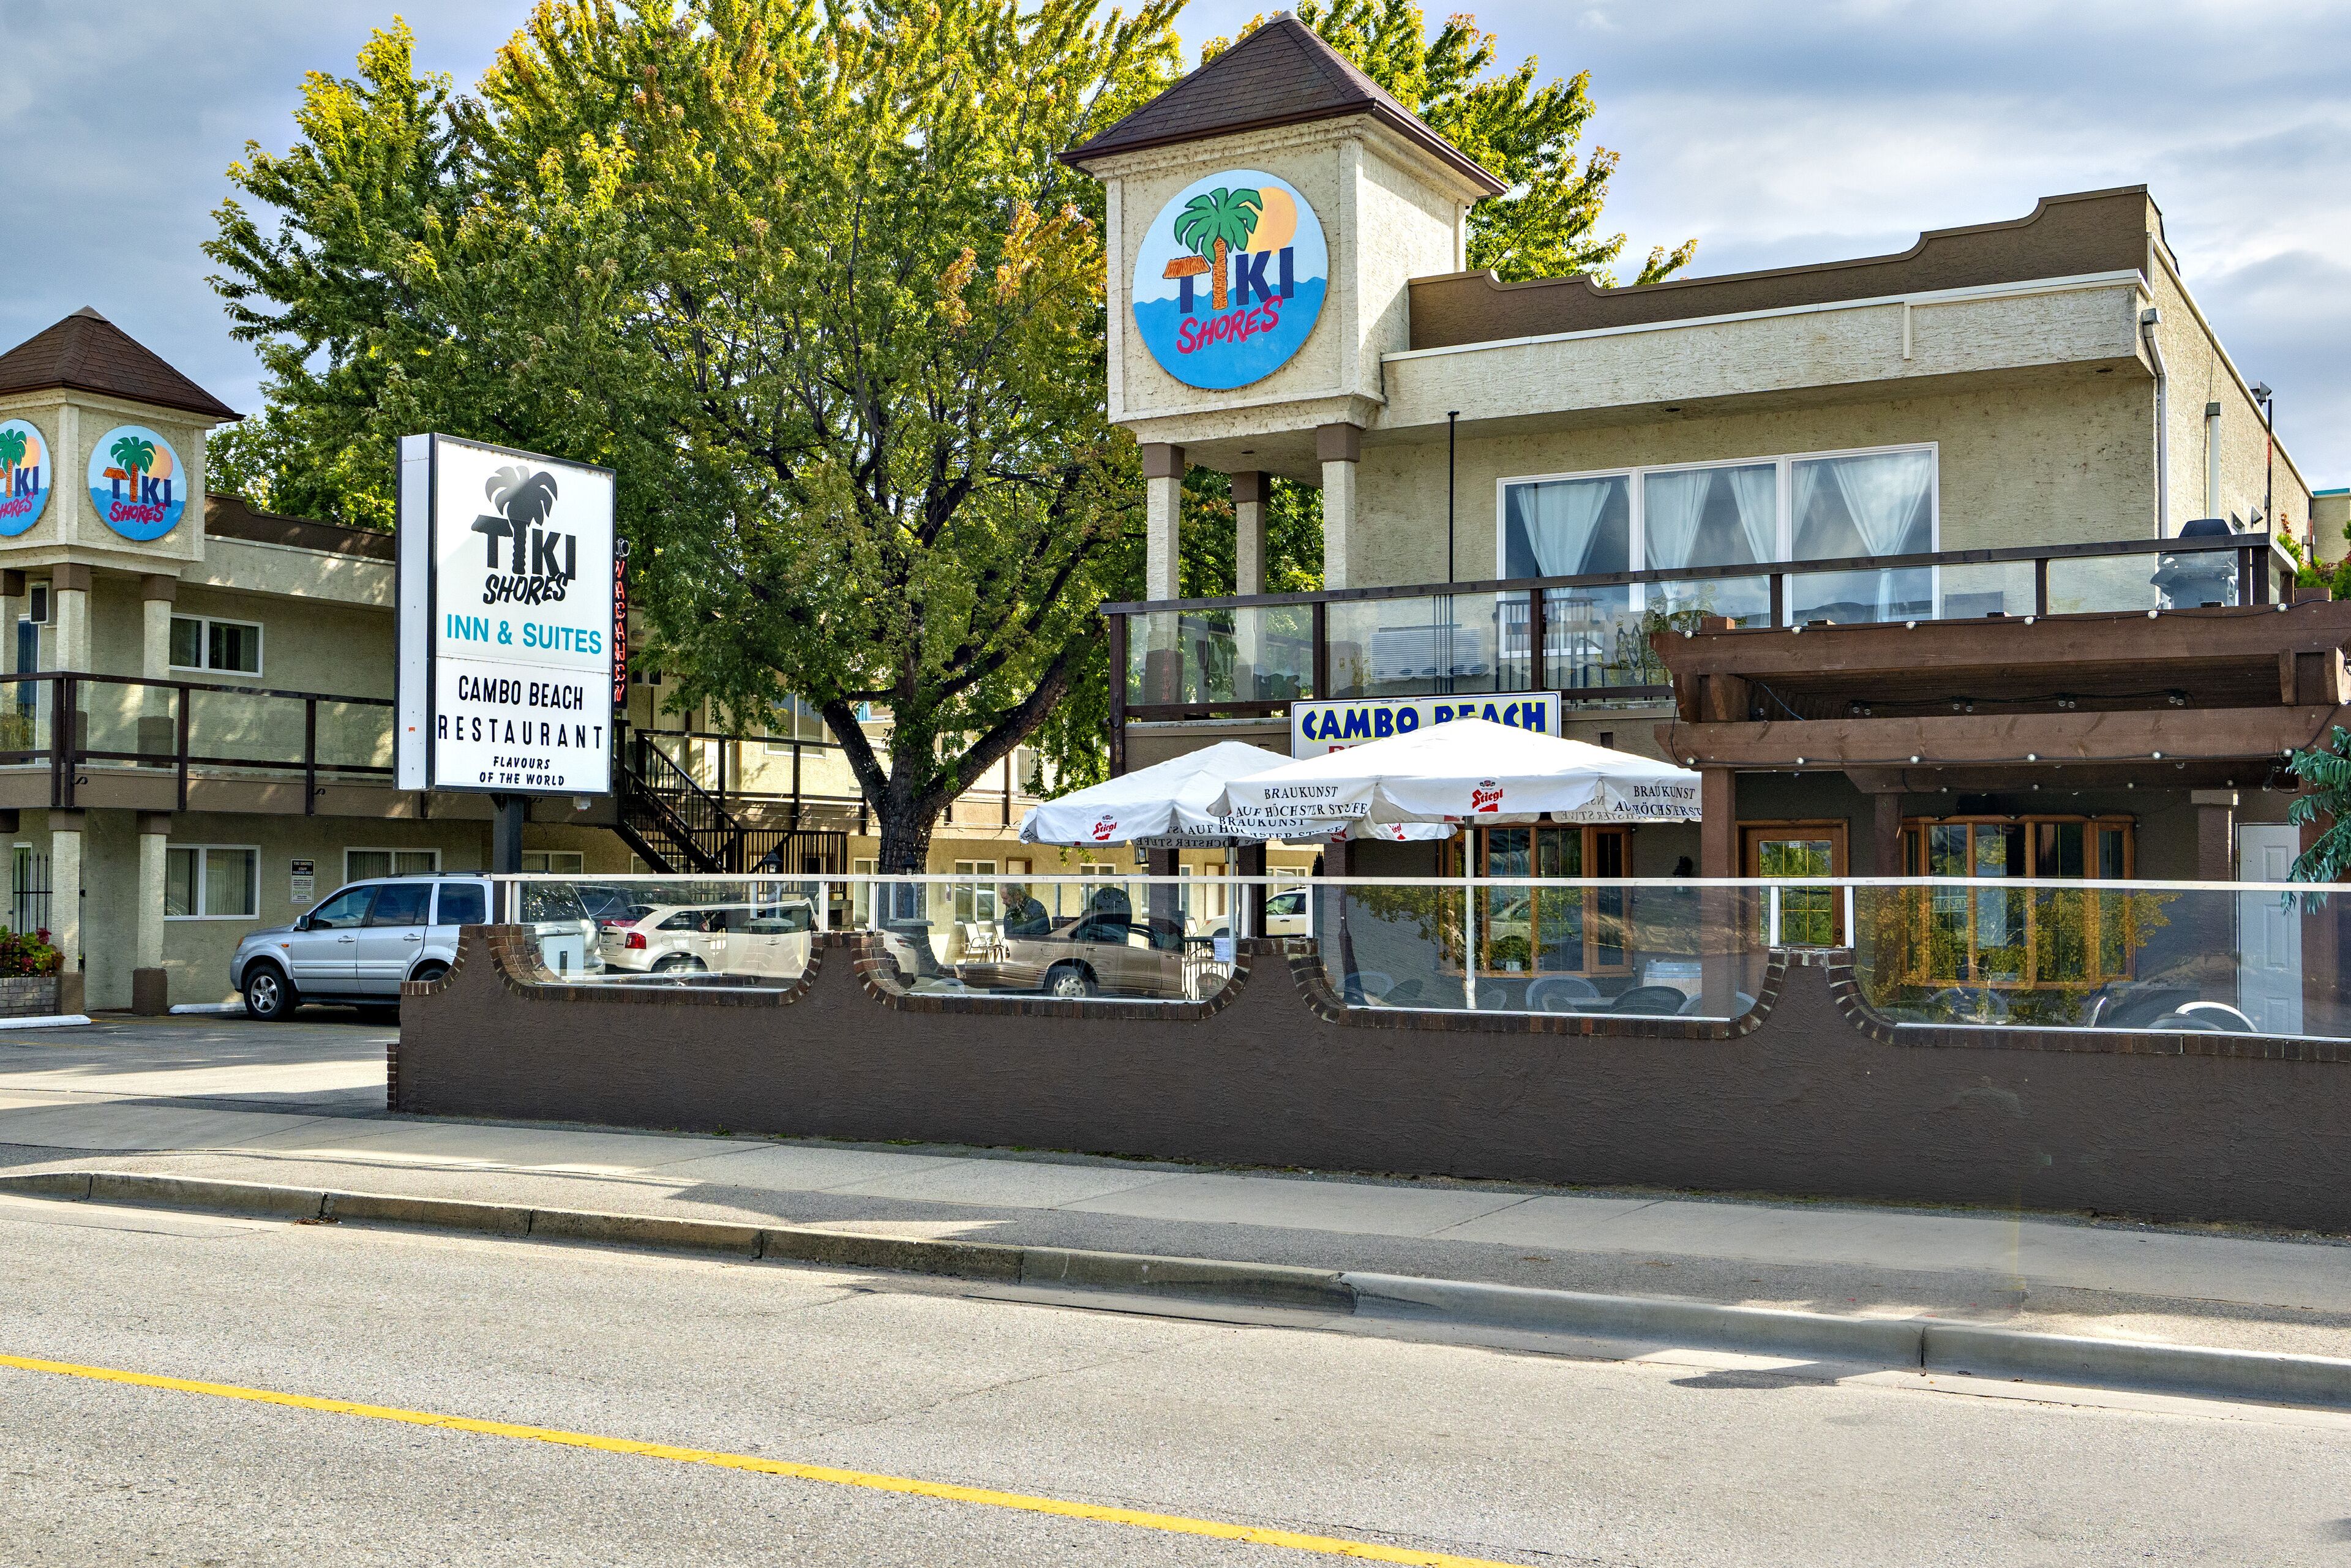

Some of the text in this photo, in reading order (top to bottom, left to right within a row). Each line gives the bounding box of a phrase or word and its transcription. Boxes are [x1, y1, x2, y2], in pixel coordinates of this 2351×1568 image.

[1162, 242, 1295, 314] TIKI
[1176, 294, 1283, 354] SHORES
[0, 463, 39, 498] IKI
[102, 463, 172, 508] TIKI
[0, 491, 34, 519] HORES
[108, 501, 167, 525] SHORES
[471, 514, 576, 580] TIKI
[482, 572, 569, 606] SHORES
[447, 613, 602, 655] INN & SUITES
[459, 675, 583, 710] CAMBO BEACH
[438, 714, 602, 749] RESTAURANT
[1302, 704, 1420, 741] CAMBO
[493, 756, 550, 770] FLAVOURS
[479, 771, 564, 786] OF THE WORLD
[1264, 786, 1338, 800] BRAUKUNST
[1472, 788, 1503, 809] Stiegl
[1633, 786, 1695, 800] BRAUKUNST
[1236, 802, 1368, 818] AUF HÖCHSTER STUFE
[1613, 801, 1634, 812] AU
[1092, 822, 1118, 836] Stiegl
[1188, 824, 1214, 835] AUF
[1219, 816, 1305, 828] BRAUKUNST
[1933, 898, 1967, 910] CLOSED
